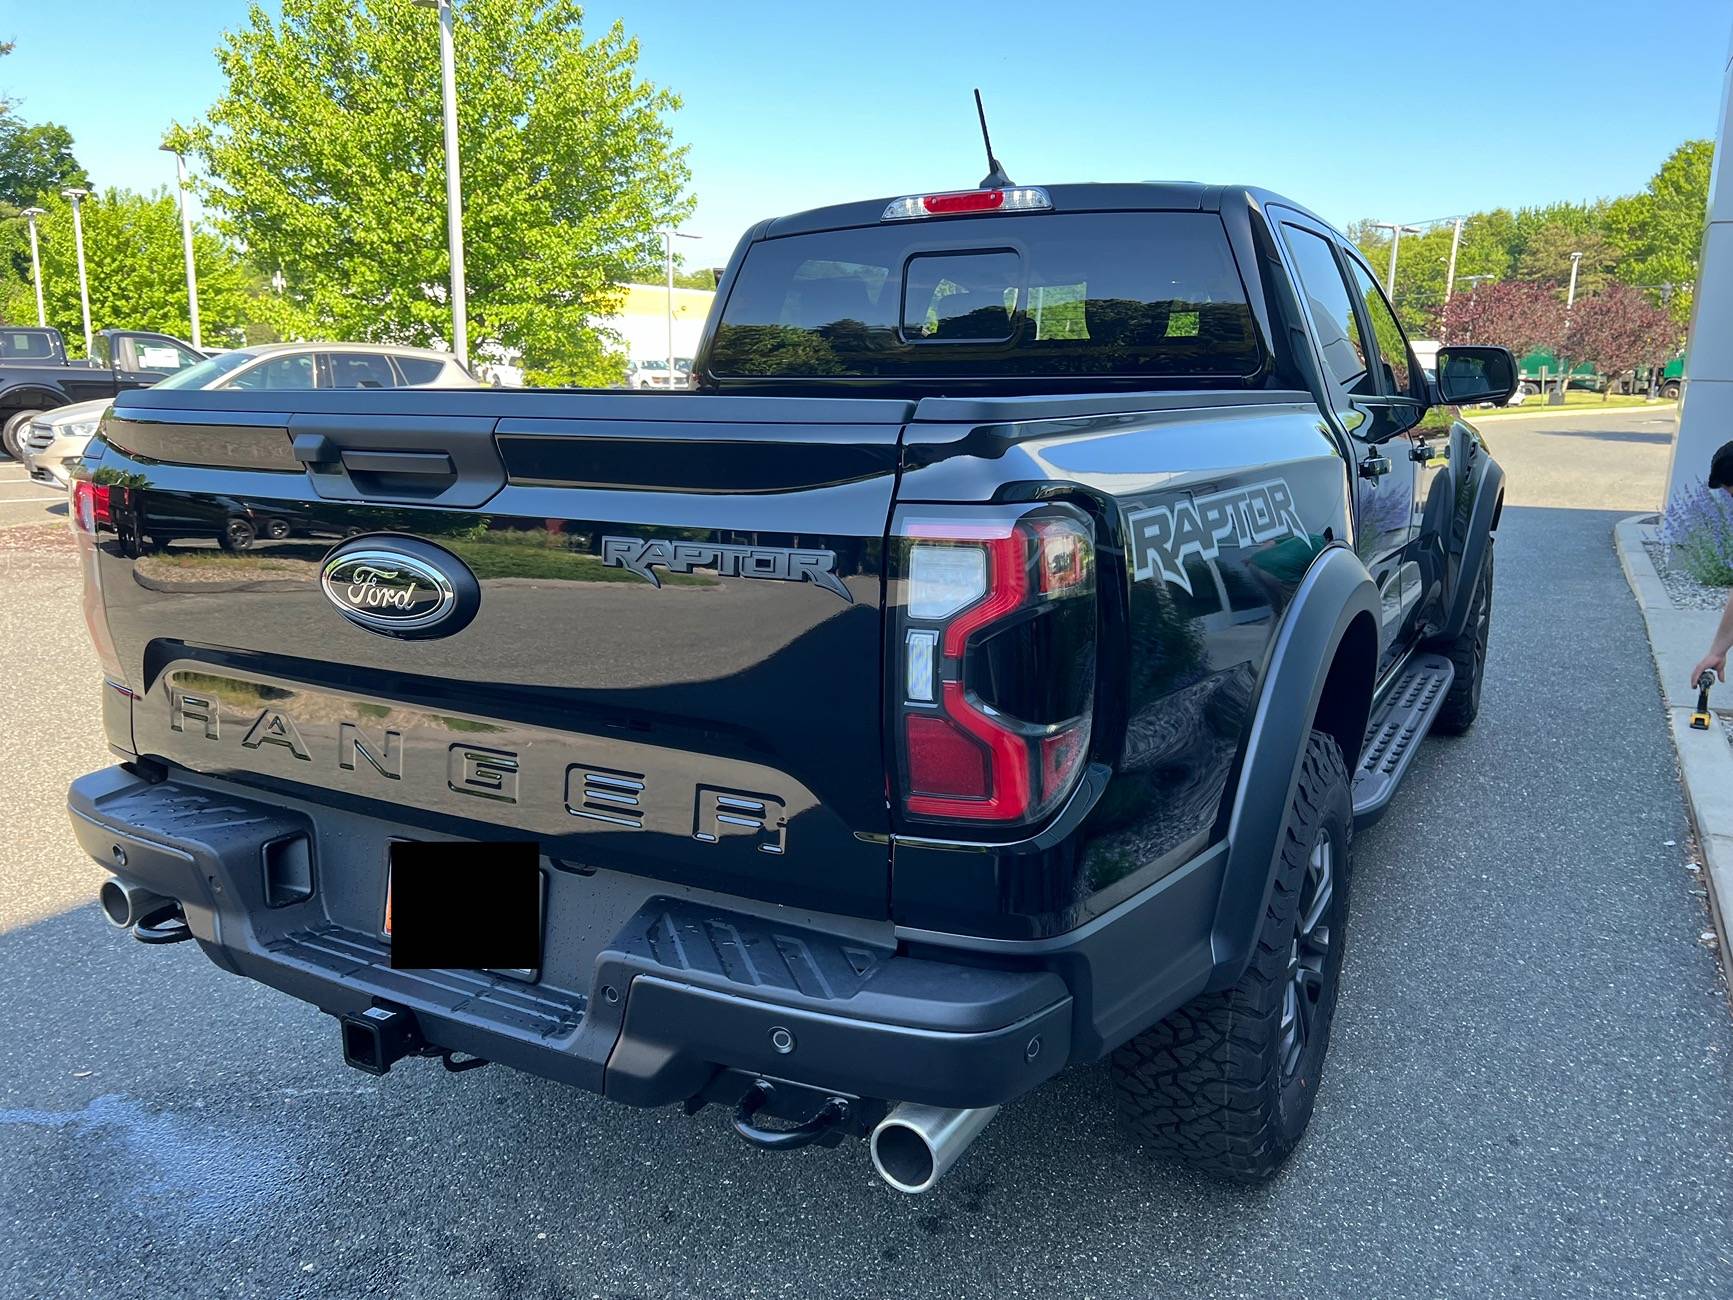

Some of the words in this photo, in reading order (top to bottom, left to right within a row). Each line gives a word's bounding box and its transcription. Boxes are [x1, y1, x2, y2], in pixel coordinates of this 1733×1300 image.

[602, 535, 854, 604] RAPTOR
[1128, 478, 1312, 597] RAPTOR
[347, 566, 416, 611] Ford
[170, 694, 786, 855] RANGER
